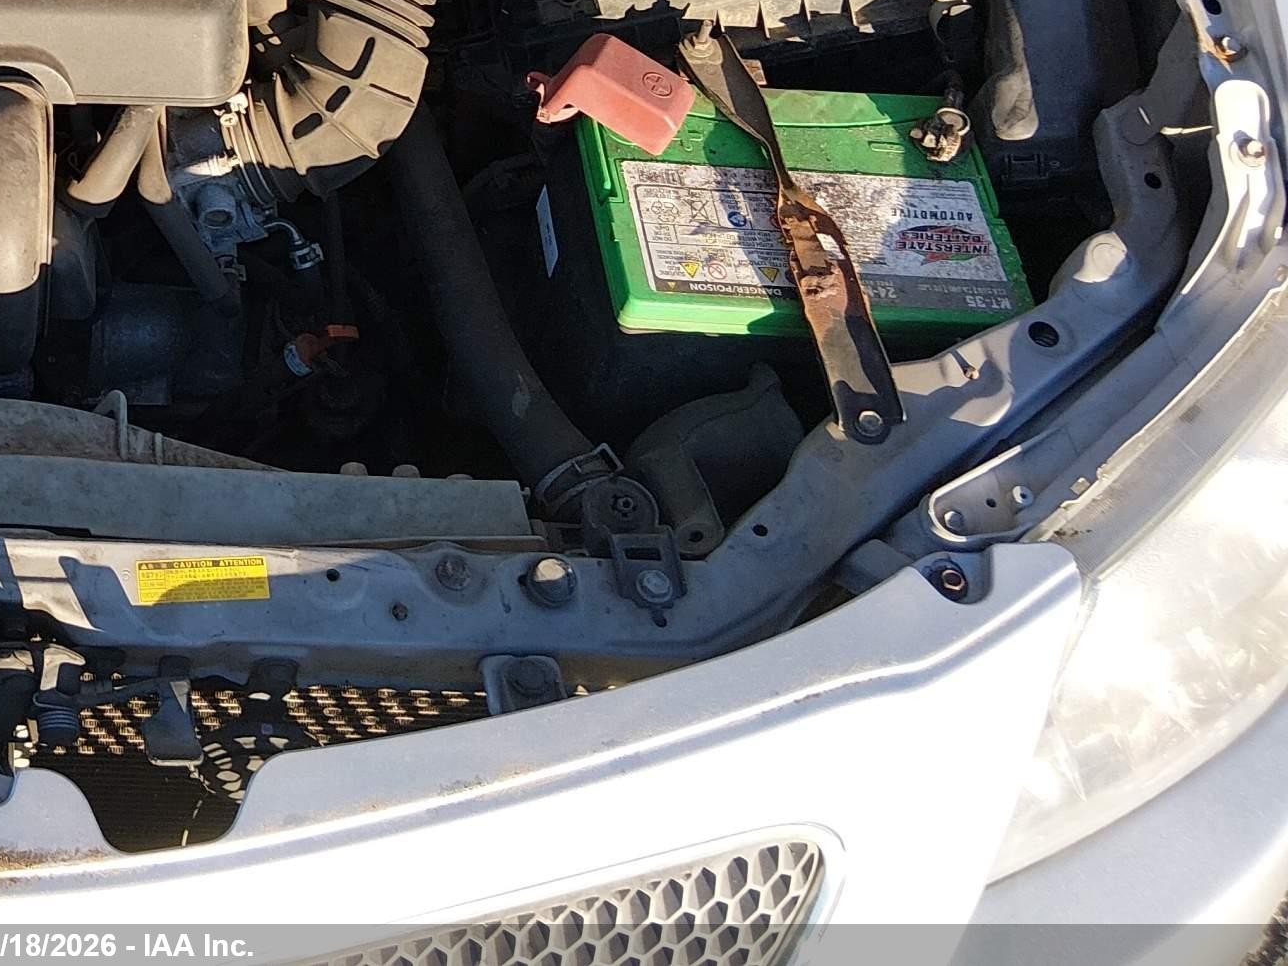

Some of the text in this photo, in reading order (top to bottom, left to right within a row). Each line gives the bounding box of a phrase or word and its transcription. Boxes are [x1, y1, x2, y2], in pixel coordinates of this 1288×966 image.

[891, 208, 973, 222] AUTOMOTIVE
[899, 231, 981, 243] BATTERIES
[895, 241, 988, 254] INTERSTATE
[689, 282, 782, 296] DANGER/POISON
[173, 560, 213, 569] CAUTION
[219, 559, 263, 568] ATTENTION
